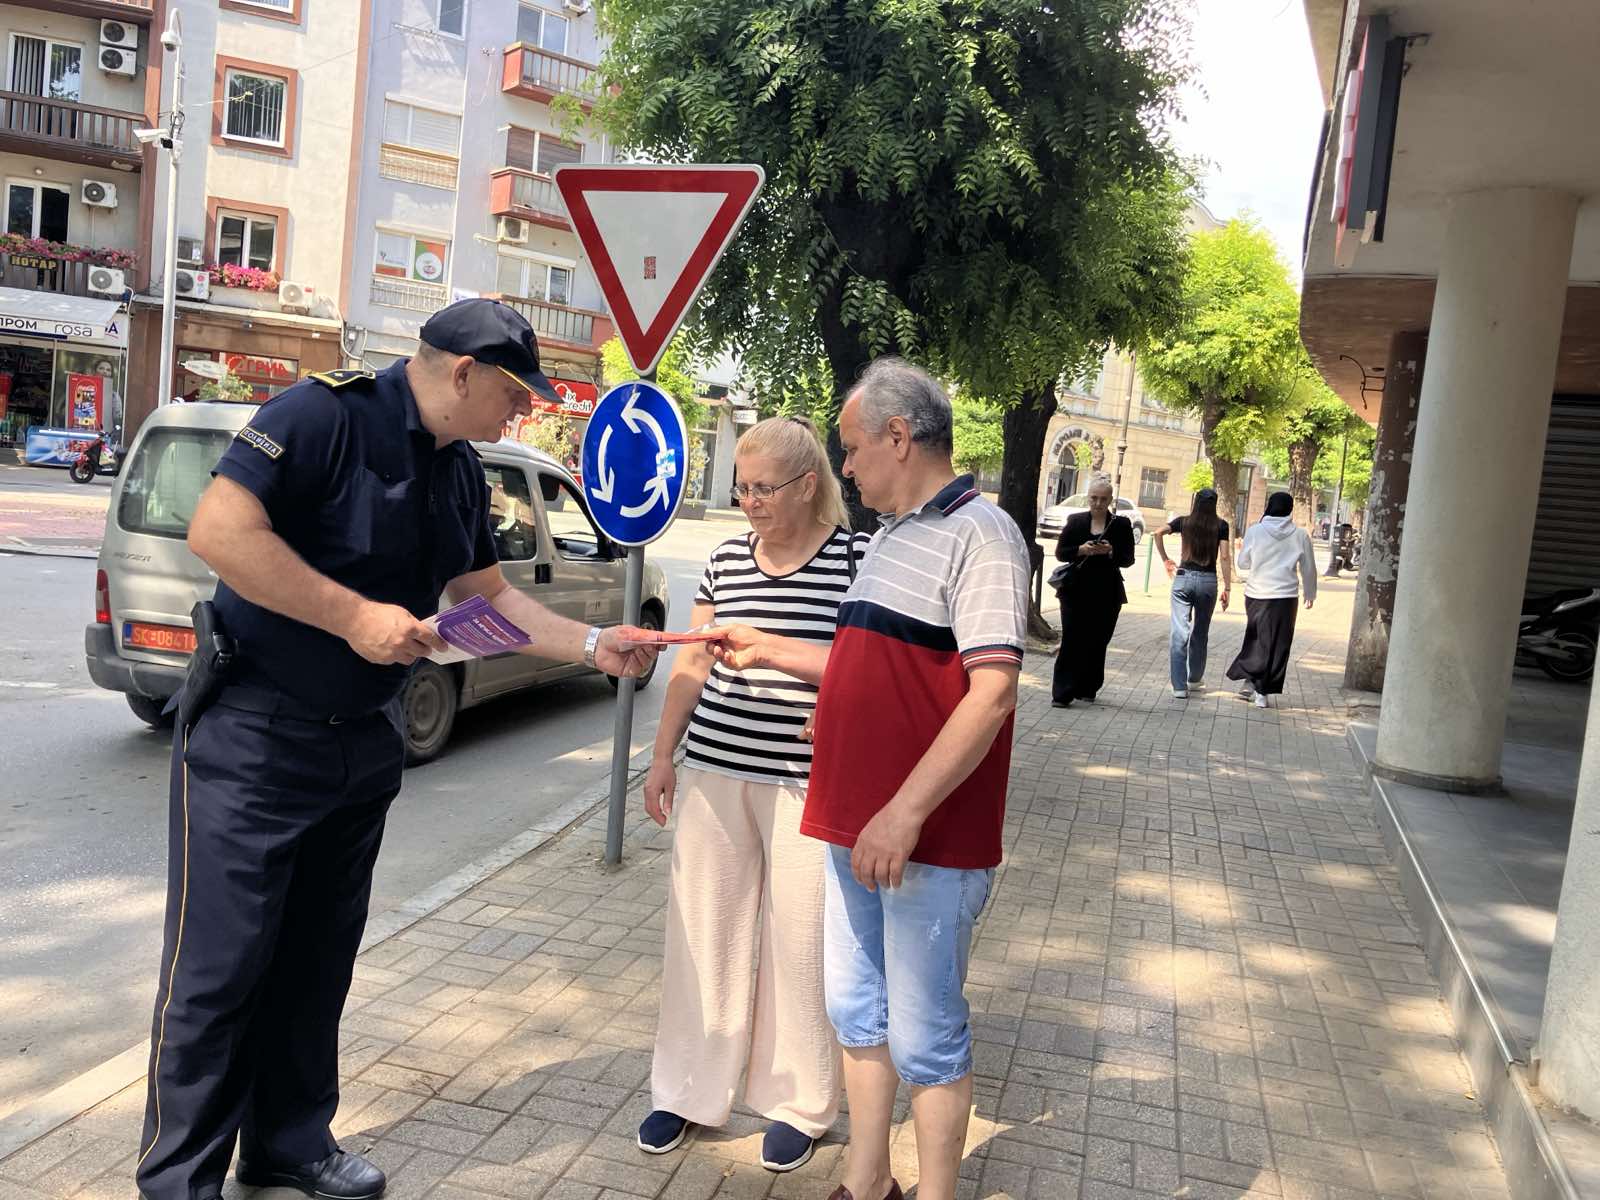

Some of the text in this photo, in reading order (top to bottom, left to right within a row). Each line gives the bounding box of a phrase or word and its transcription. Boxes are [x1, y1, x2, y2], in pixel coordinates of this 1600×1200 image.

[11, 255, 57, 270] НОТАР
[54, 323, 93, 337] rosa
[562, 400, 592, 412] credit
